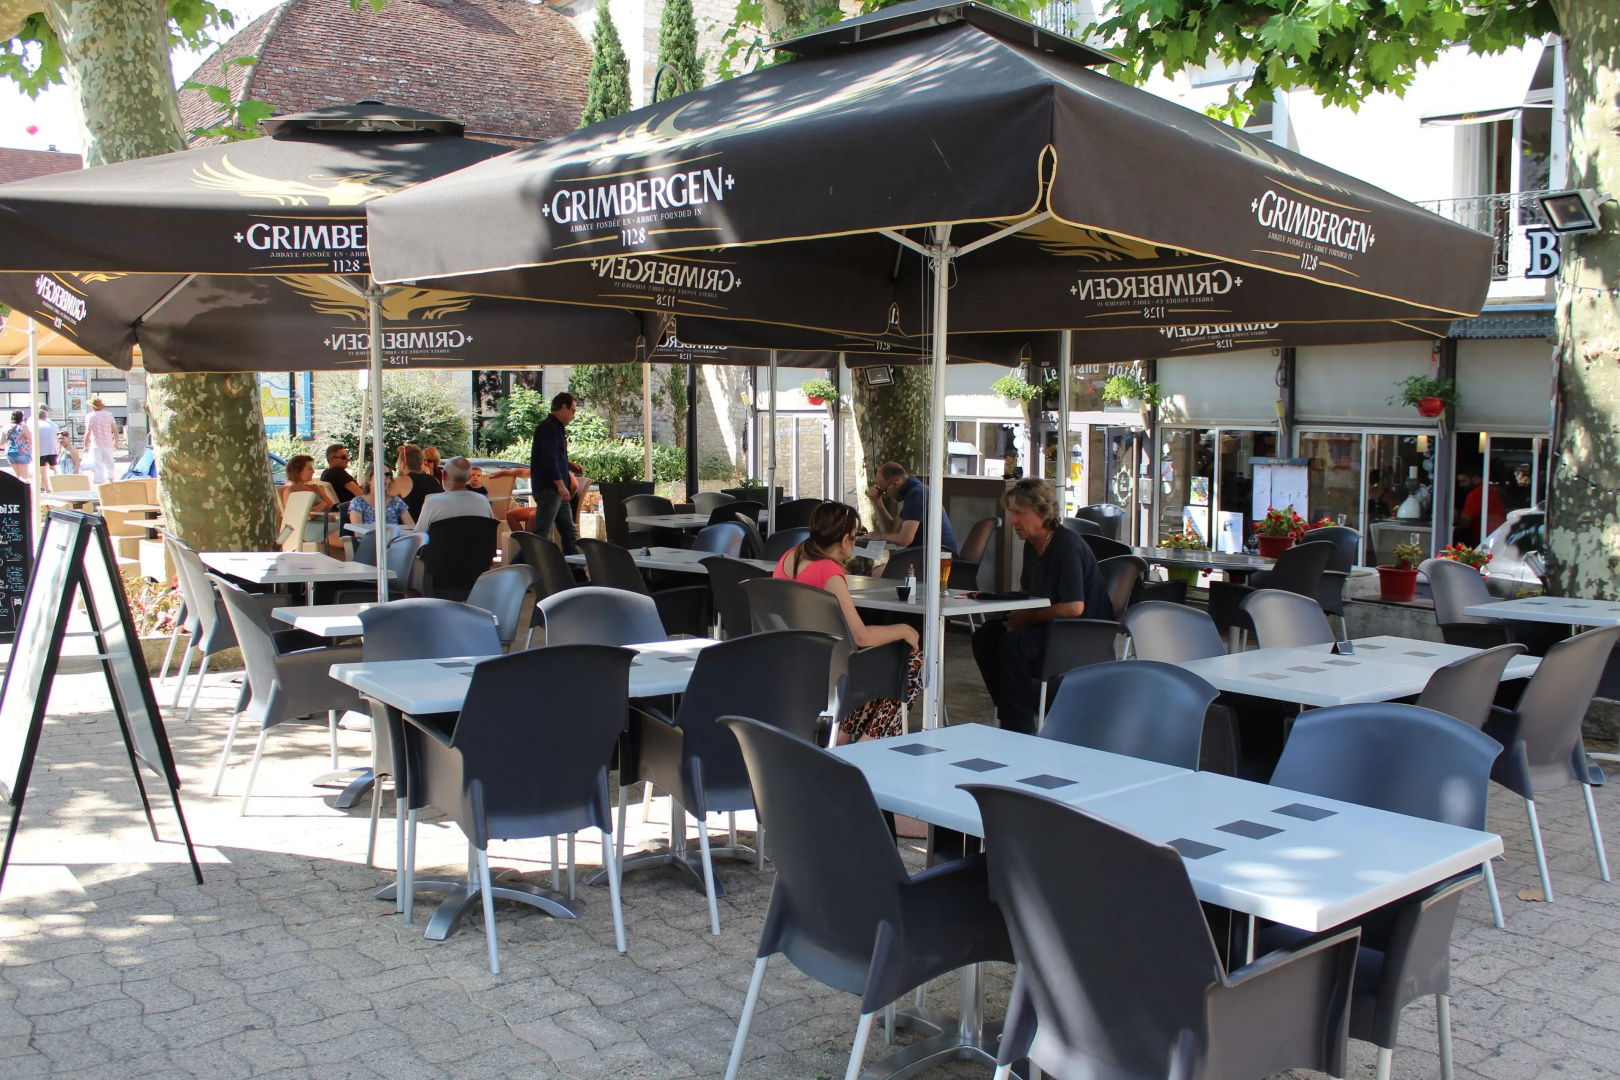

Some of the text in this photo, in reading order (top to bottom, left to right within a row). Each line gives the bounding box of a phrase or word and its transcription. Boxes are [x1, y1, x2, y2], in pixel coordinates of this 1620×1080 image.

[552, 167, 723, 224] GRIMBERGEN
[570, 208, 702, 233] ABBAYE FONDÉE EN ABBEY FOUNDED IN
[1257, 190, 1371, 253] GRIMBERGEN
[246, 223, 368, 250] GRIMBE
[622, 227, 646, 247] 1128
[1267, 232, 1286, 243] ABBAYE
[1313, 244, 1328, 253] ABBEY
[302, 250, 332, 258] FONDÉE
[1301, 253, 1318, 271] 1128
[1526, 229, 1560, 277] B
[333, 260, 360, 272] 1128
[876, 341, 891, 351] 1128
[1043, 368, 1058, 383] Le
[1069, 363, 1100, 375] rand
